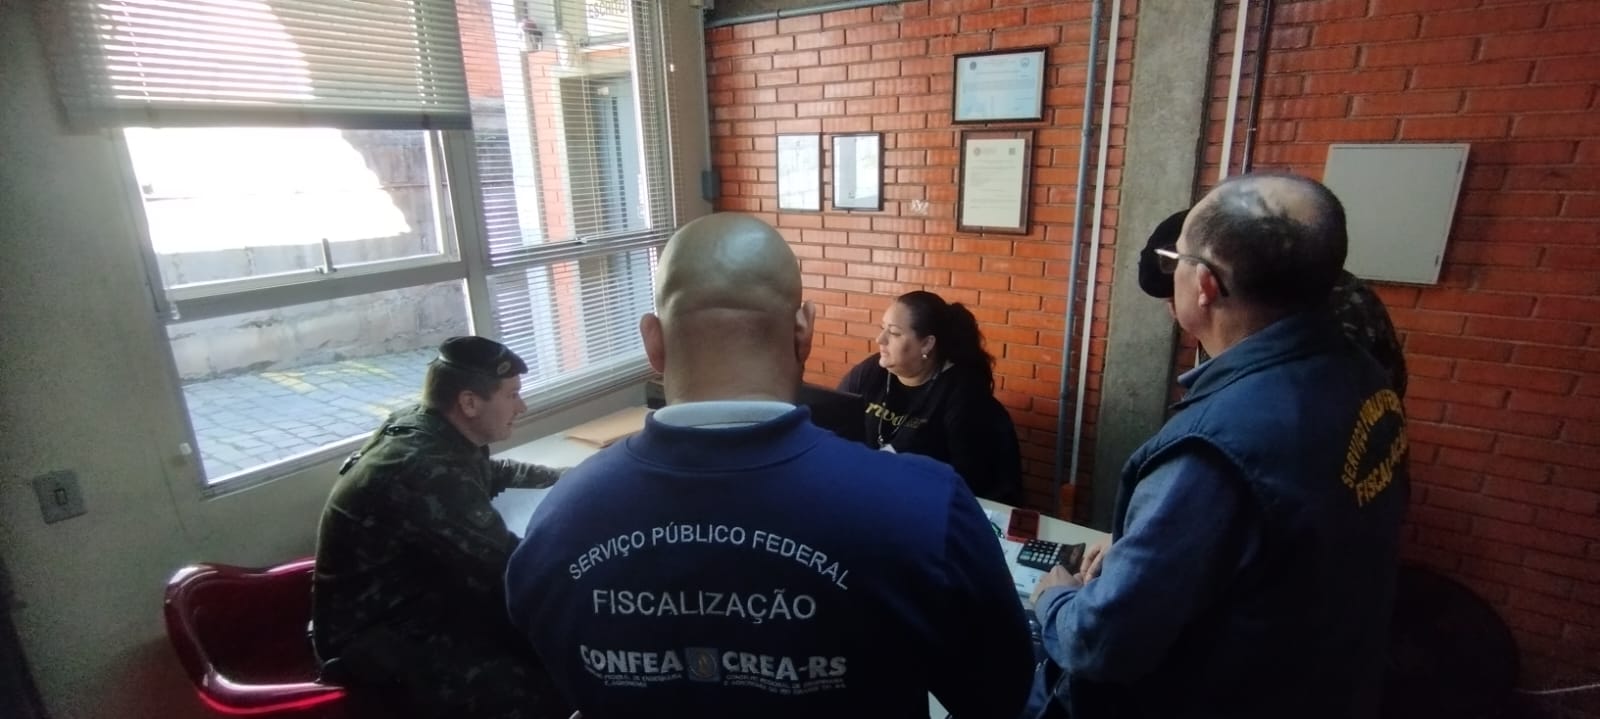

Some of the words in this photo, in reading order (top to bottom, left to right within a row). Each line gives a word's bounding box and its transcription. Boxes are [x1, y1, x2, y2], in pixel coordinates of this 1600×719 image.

[569, 530, 646, 580] SERVIÇO
[651, 522, 746, 546] PÚBLICO
[752, 530, 849, 590] FEDERAL
[592, 588, 817, 624] FISCALIZAÇÃO
[580, 644, 683, 673] CONFEA
[722, 651, 847, 681] CREA-RS
